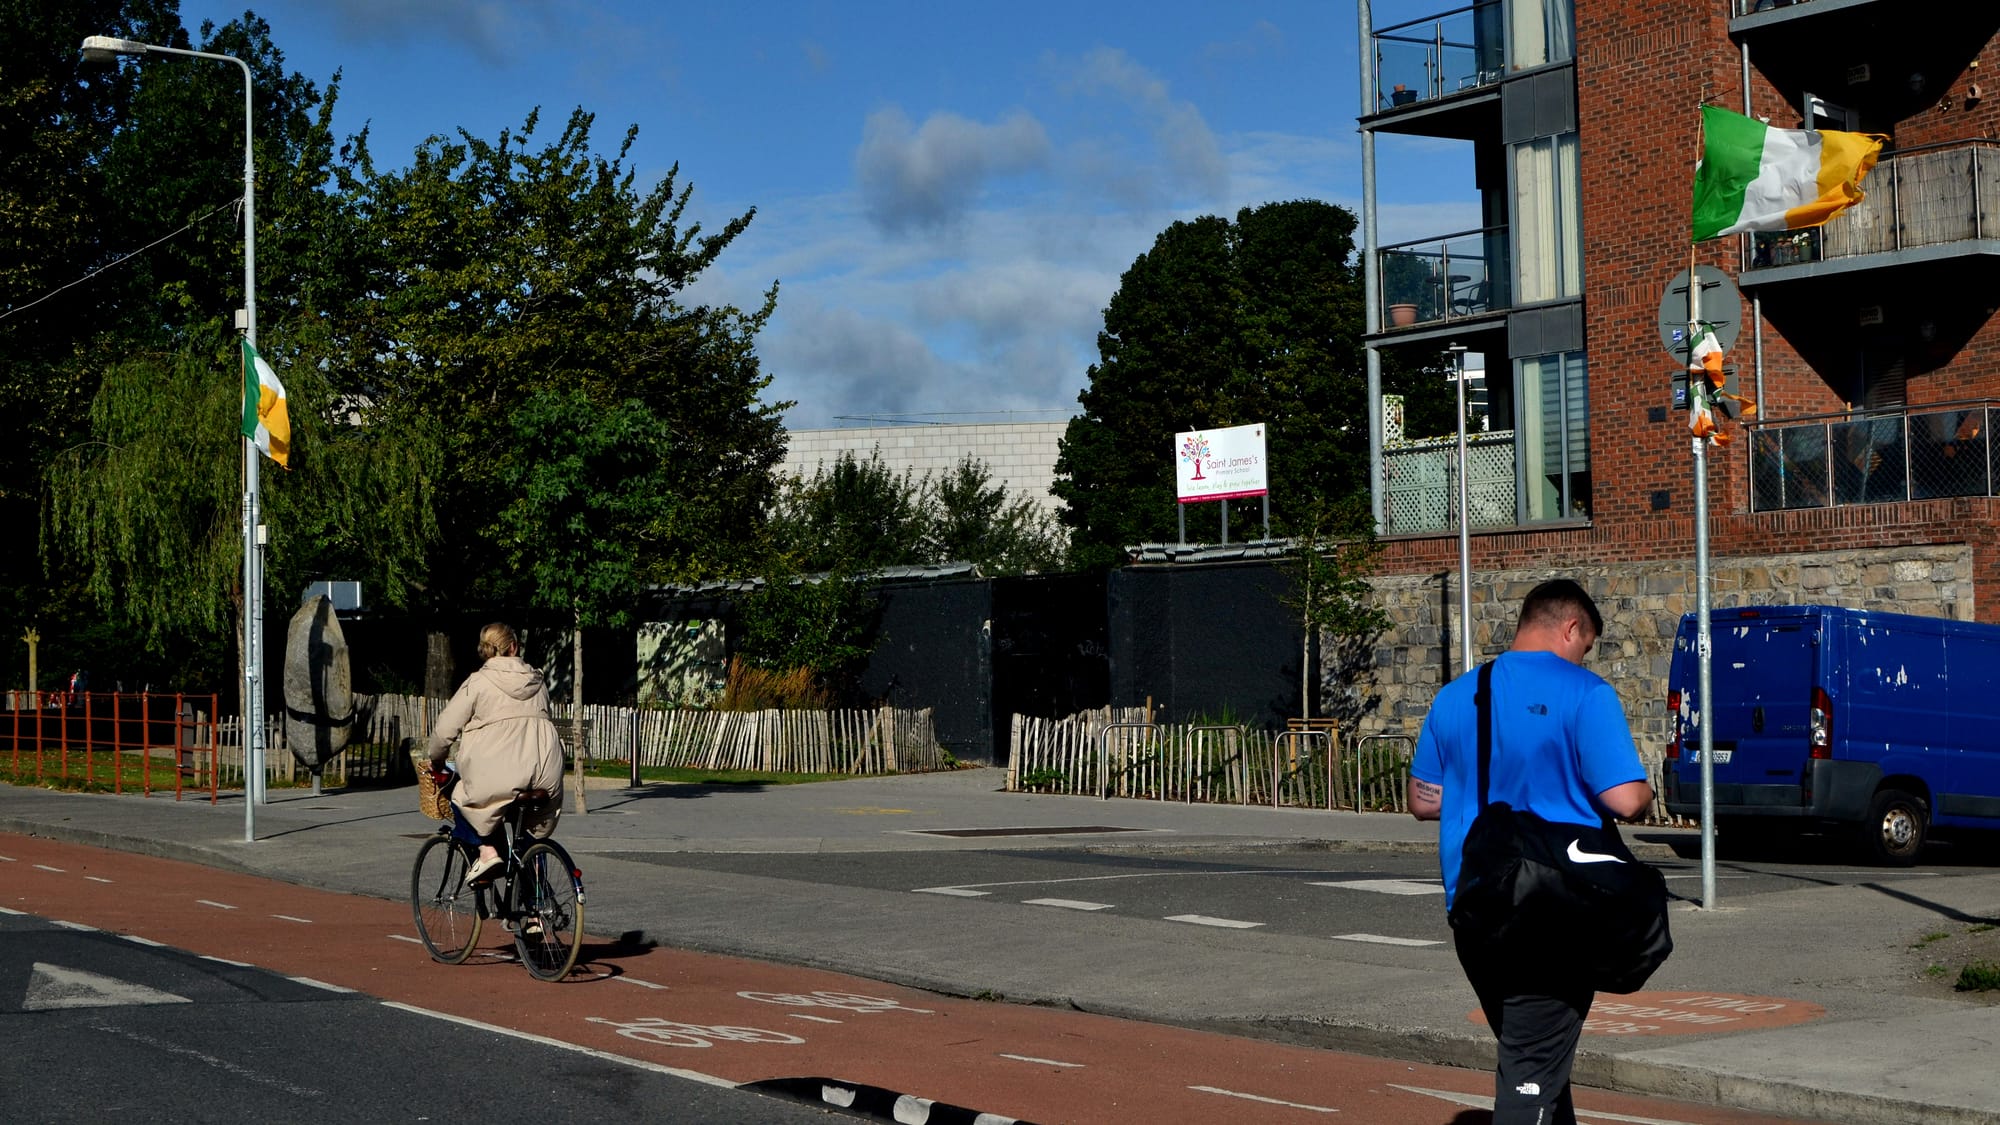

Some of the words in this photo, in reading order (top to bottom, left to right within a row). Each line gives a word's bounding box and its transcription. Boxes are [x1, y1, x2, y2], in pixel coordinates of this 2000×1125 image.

[1206, 459, 1226, 470] Saint
[1228, 455, 1258, 467] James's
[1659, 996, 1786, 1013] ONLY
